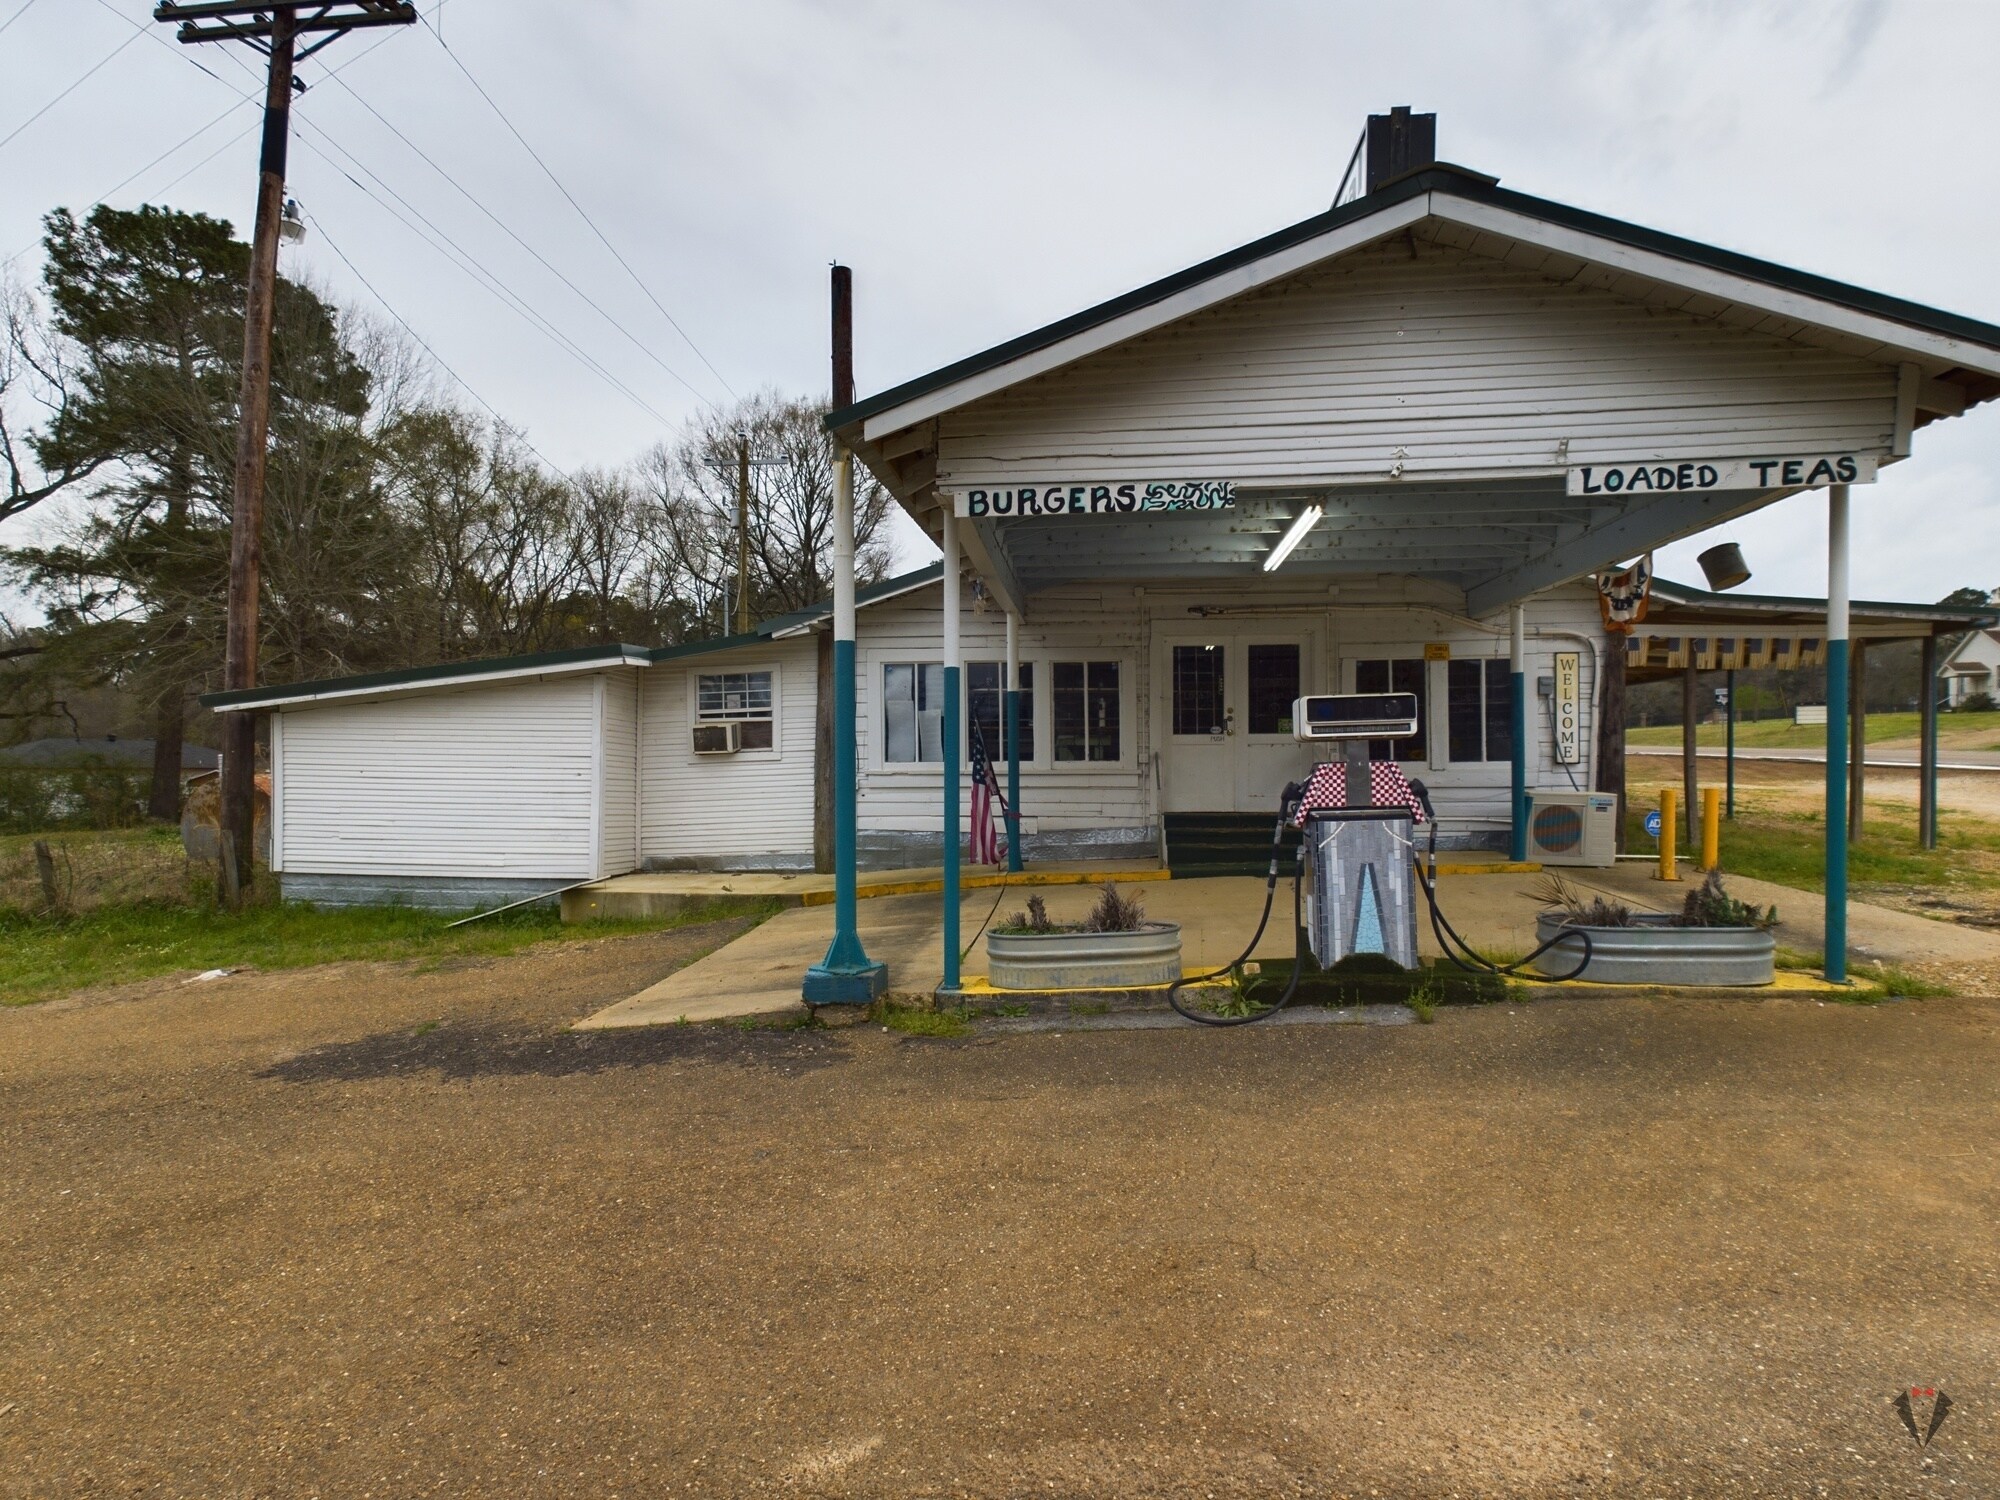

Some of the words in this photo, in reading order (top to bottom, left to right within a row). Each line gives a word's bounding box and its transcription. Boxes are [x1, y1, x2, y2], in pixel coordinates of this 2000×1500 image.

[1581, 463, 1719, 494] LOADED
[1749, 456, 1858, 487] TEAS
[968, 484, 1136, 517] BURGERS
[1560, 658, 1575, 759] WELCOME
[1648, 818, 1661, 828] AD
